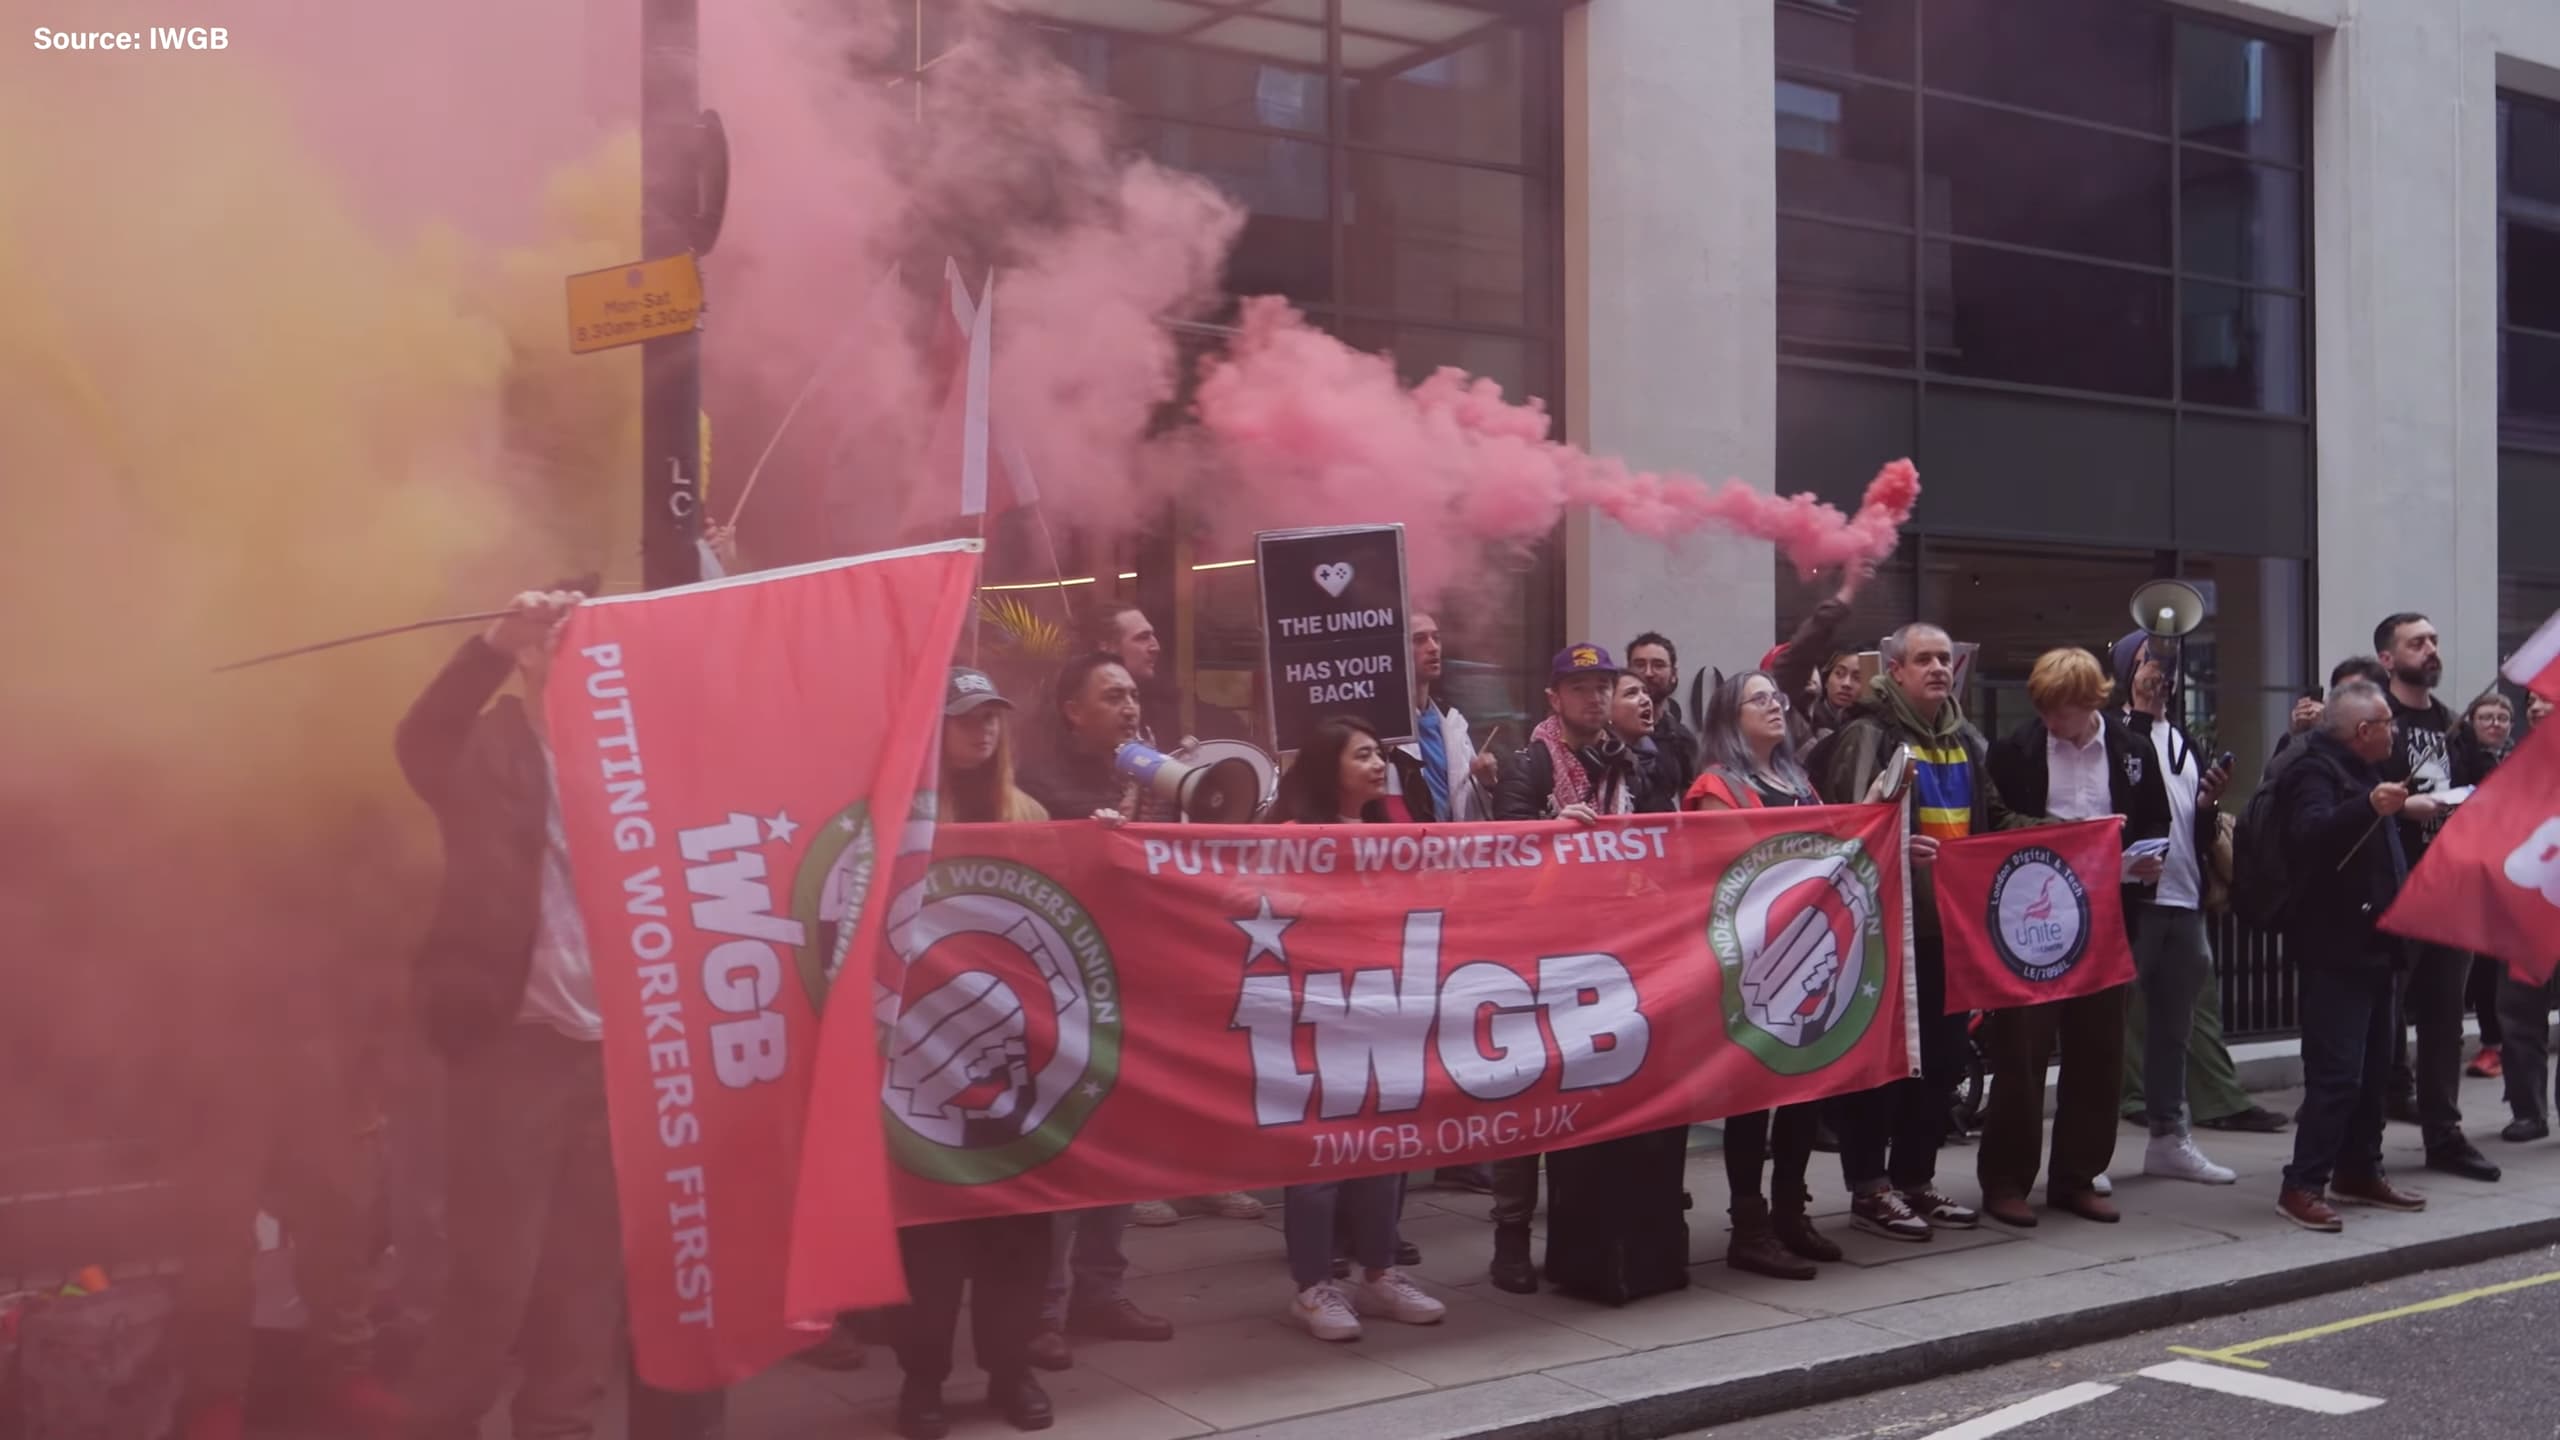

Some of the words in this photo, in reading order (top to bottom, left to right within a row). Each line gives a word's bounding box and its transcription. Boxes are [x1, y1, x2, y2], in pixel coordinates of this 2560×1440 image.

[1278, 616, 1322, 637] THE
[1327, 608, 1393, 632] UNION
[1286, 661, 1331, 683] HAS
[1335, 655, 1392, 677] YOUR
[1310, 680, 1375, 704] BACK!
[1143, 837, 1337, 875] PUTTING
[1353, 834, 1543, 872] WORKERS
[1552, 826, 1669, 865] FIRST
[1991, 864, 2012, 905] London
[2012, 848, 2051, 866] Digital
[2064, 867, 2084, 897] Tech
[1714, 842, 1777, 966] INDEPENDENT
[949, 864, 1078, 928] WORKERS
[1071, 925, 1117, 1025] UNION
[2015, 920, 2063, 946] unite
[581, 643, 656, 852] PUTTING
[623, 866, 699, 1148] WORKERS
[665, 1166, 714, 1329] FIRST
[1308, 1102, 1584, 1168] IWGB.ORG.UK
